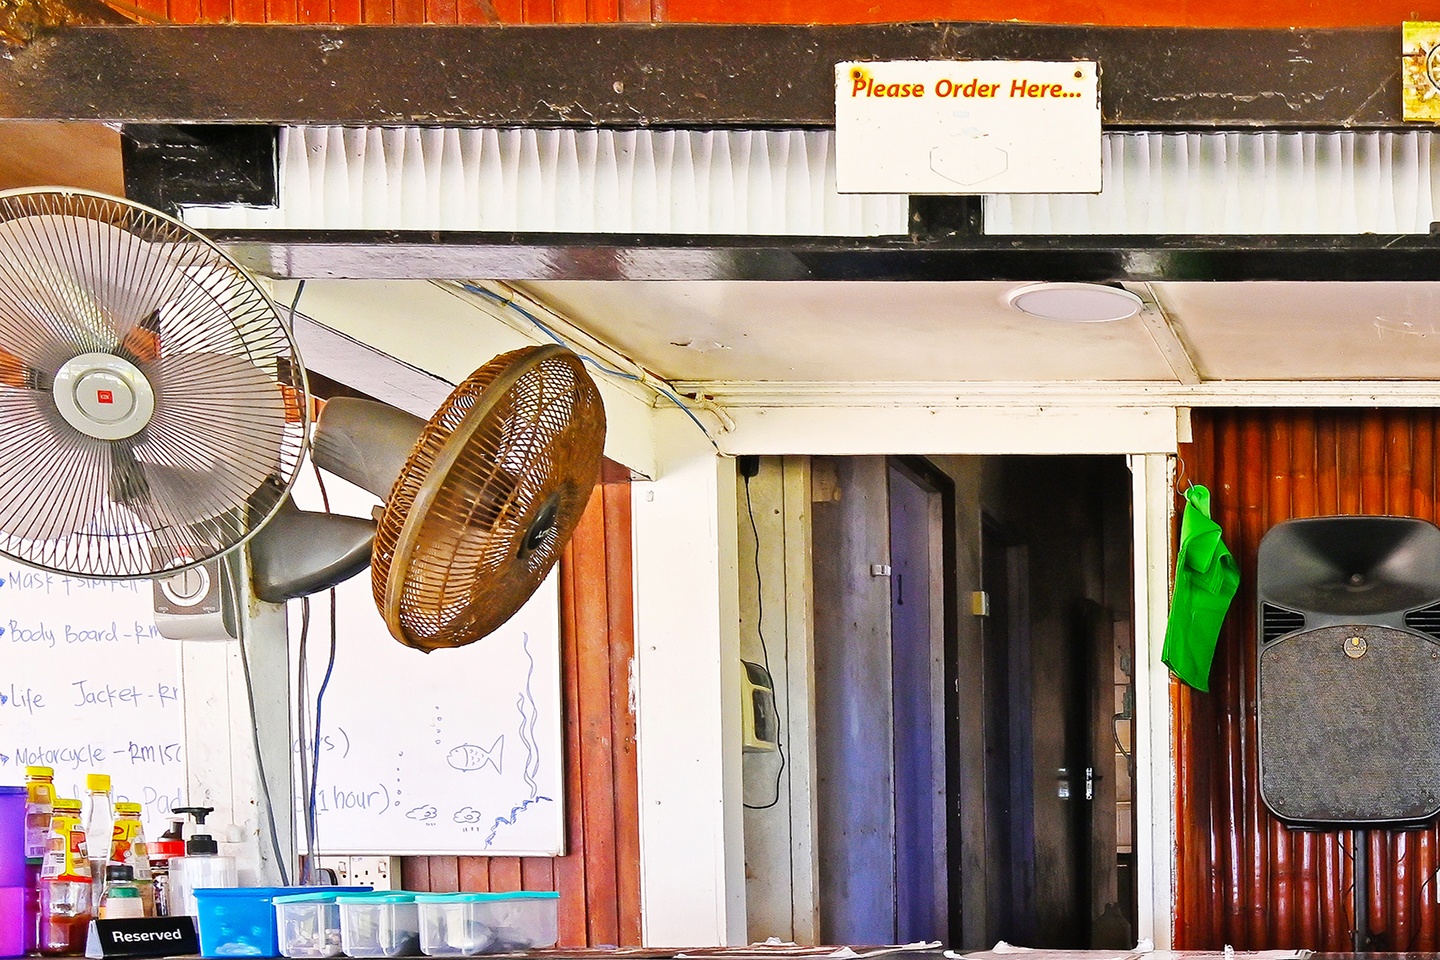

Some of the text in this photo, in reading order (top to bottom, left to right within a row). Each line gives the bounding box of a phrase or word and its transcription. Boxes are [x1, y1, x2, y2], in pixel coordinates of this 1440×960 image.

[851, 78, 1082, 98] Please Order Here...
[9, 619, 56, 648] Body
[65, 621, 118, 643] Board
[11, 683, 46, 714] Life
[72, 680, 143, 708] Jacket
[15, 744, 106, 770] Motorcycle
[112, 928, 182, 943] Reserved
